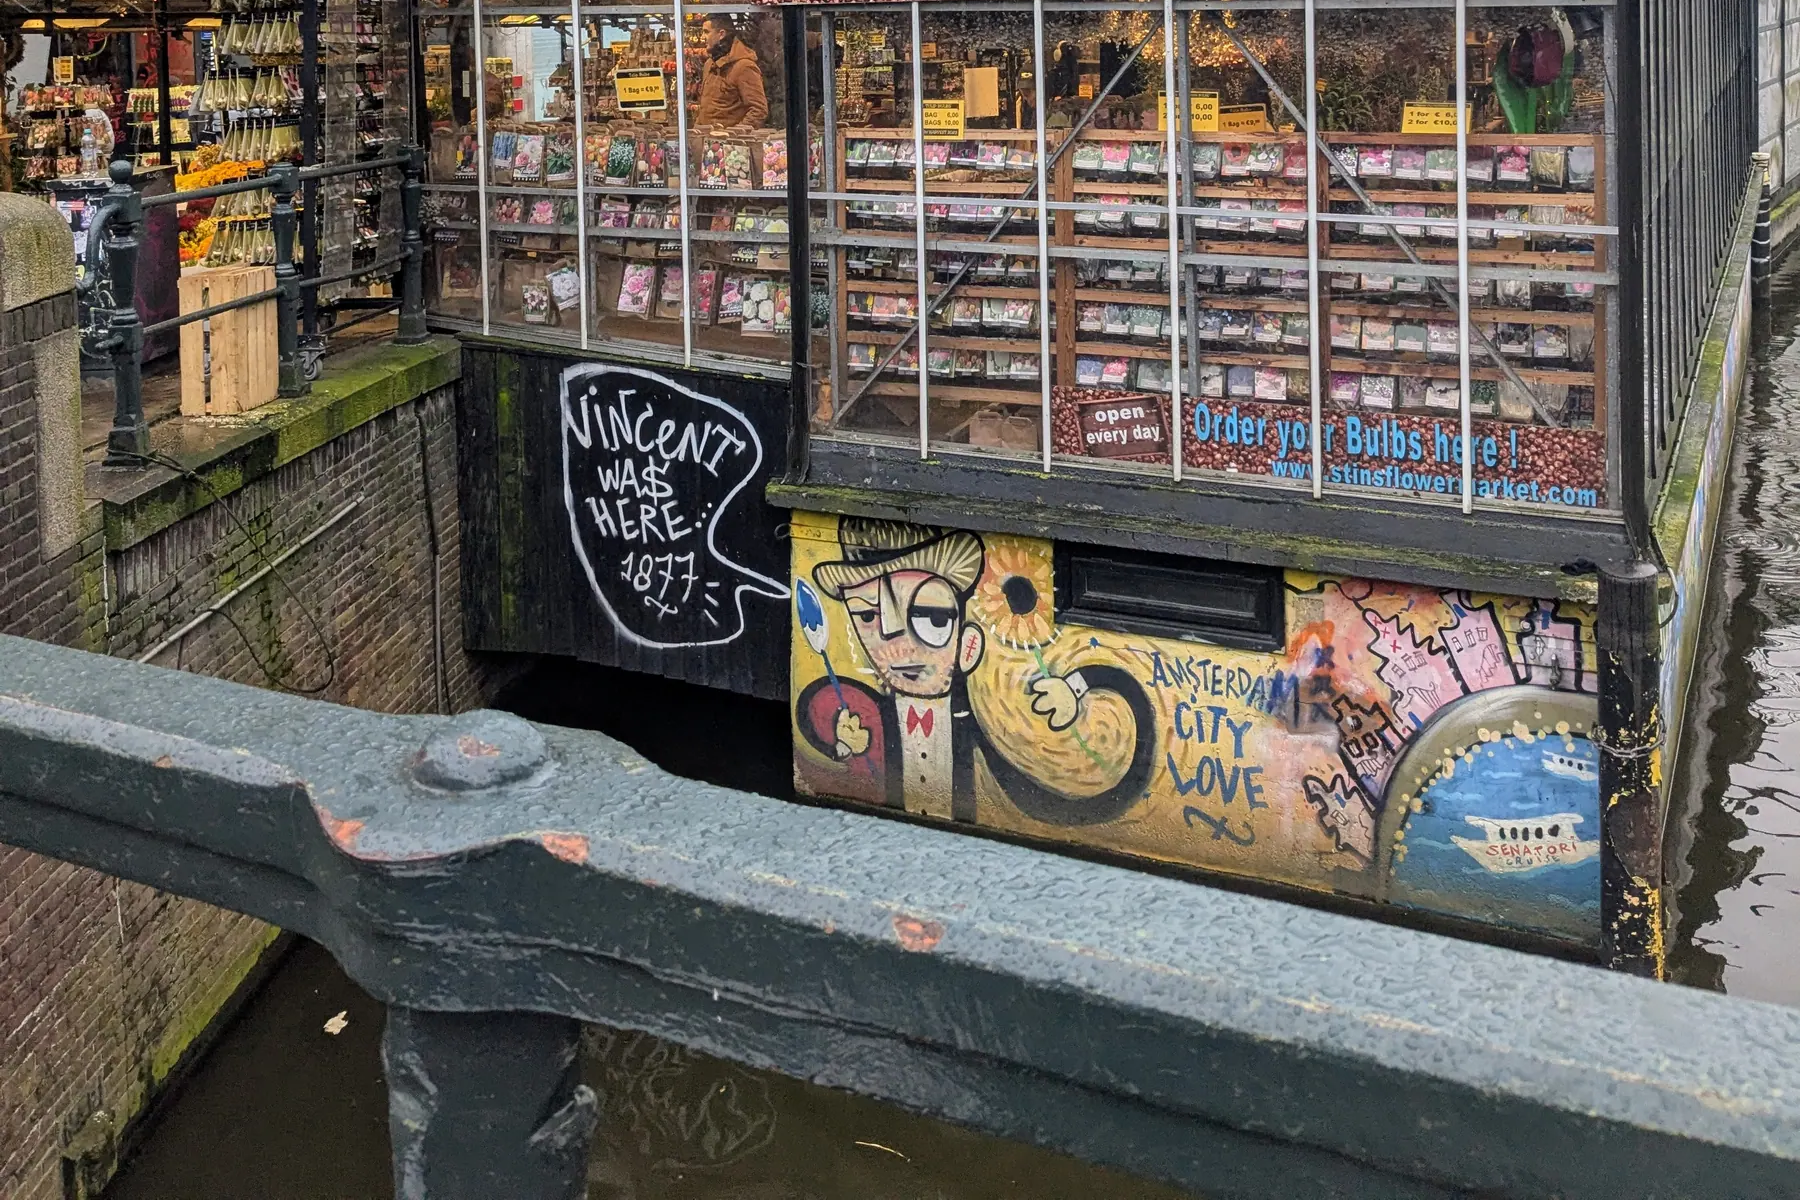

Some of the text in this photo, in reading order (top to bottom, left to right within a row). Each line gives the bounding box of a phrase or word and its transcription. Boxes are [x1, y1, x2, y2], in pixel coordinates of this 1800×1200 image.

[1095, 406, 1144, 424] open
[1086, 424, 1161, 445] every day
[1194, 402, 1266, 446] Order
[1277, 420, 1335, 459] yor
[1346, 416, 1422, 461] Bulbs
[1435, 423, 1497, 467] here
[621, 552, 699, 603] 1877
[1167, 752, 1269, 811] LOVE
[1506, 854, 1560, 866] CRUISE
